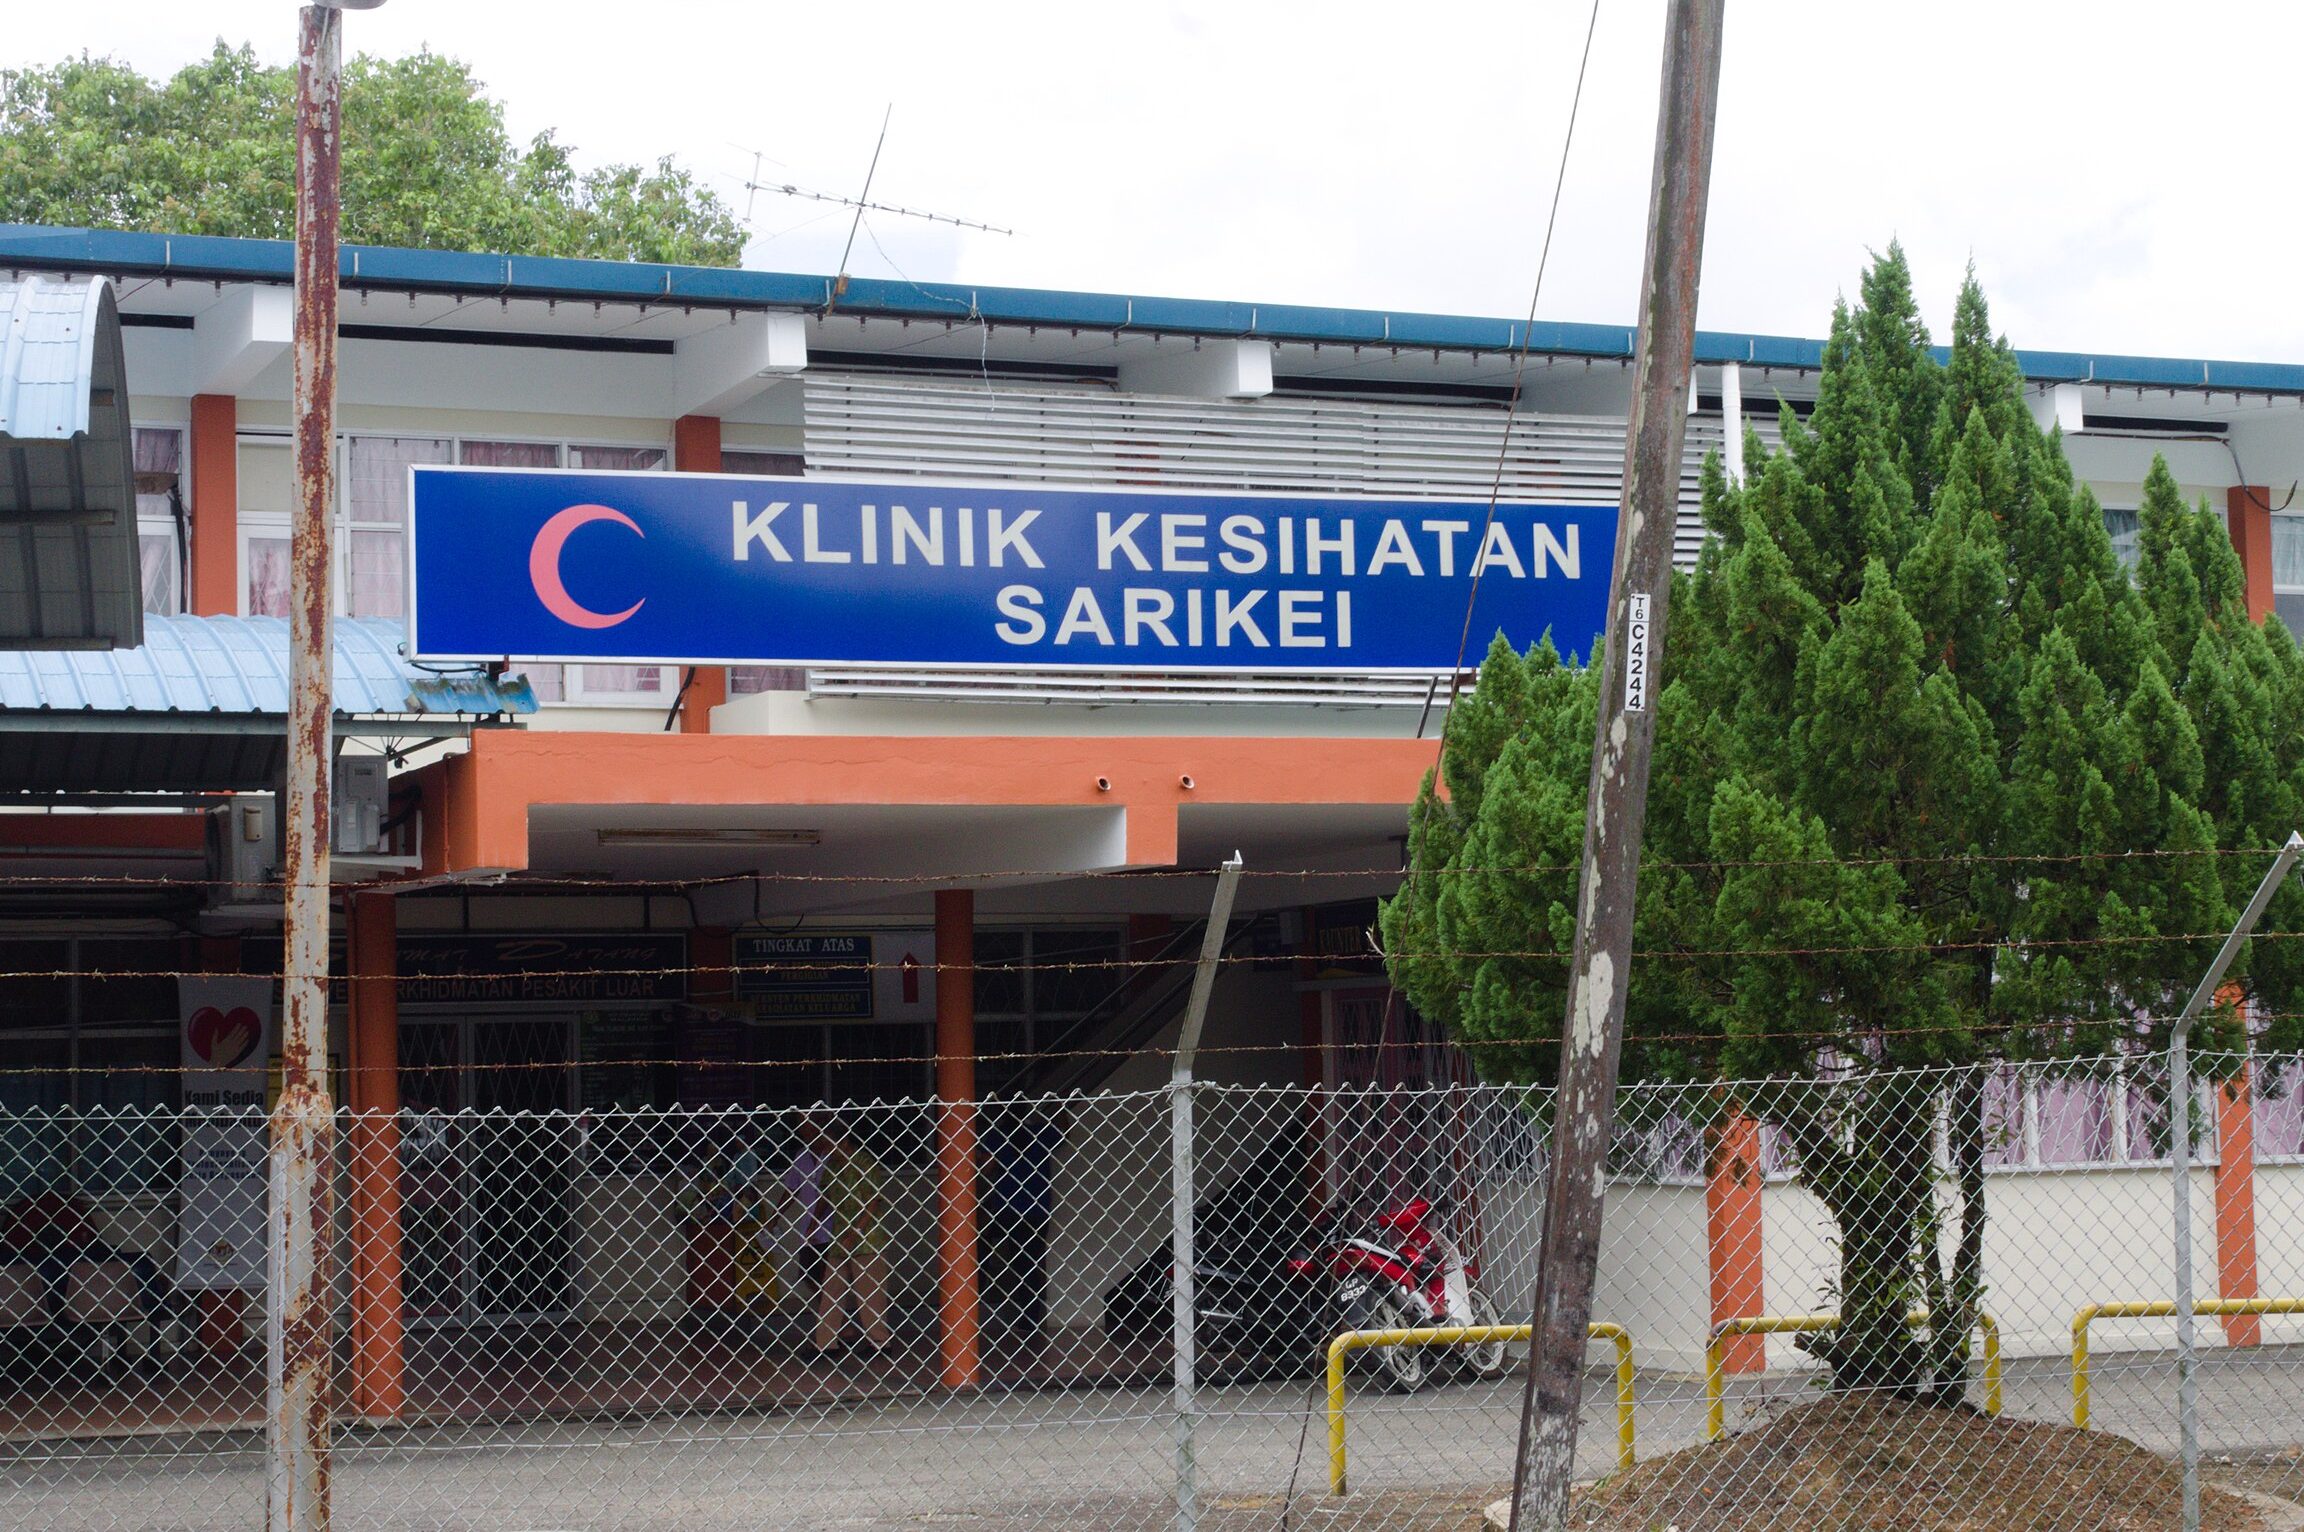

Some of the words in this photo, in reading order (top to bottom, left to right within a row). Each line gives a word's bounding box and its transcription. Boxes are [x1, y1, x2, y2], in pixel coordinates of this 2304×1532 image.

[732, 500, 1045, 568] KLINIK
[1096, 511, 1581, 580] KESIHATAN
[995, 585, 1351, 647] SARIKEI
[752, 938, 812, 953] TINGKAT
[821, 938, 855, 952] ATAS
[396, 979, 513, 998] RKHIDMATAN
[521, 978, 599, 997] PESAKIT
[605, 978, 655, 996] LUAR
[184, 1090, 220, 1105] Kami
[222, 1089, 264, 1105] Sedia
